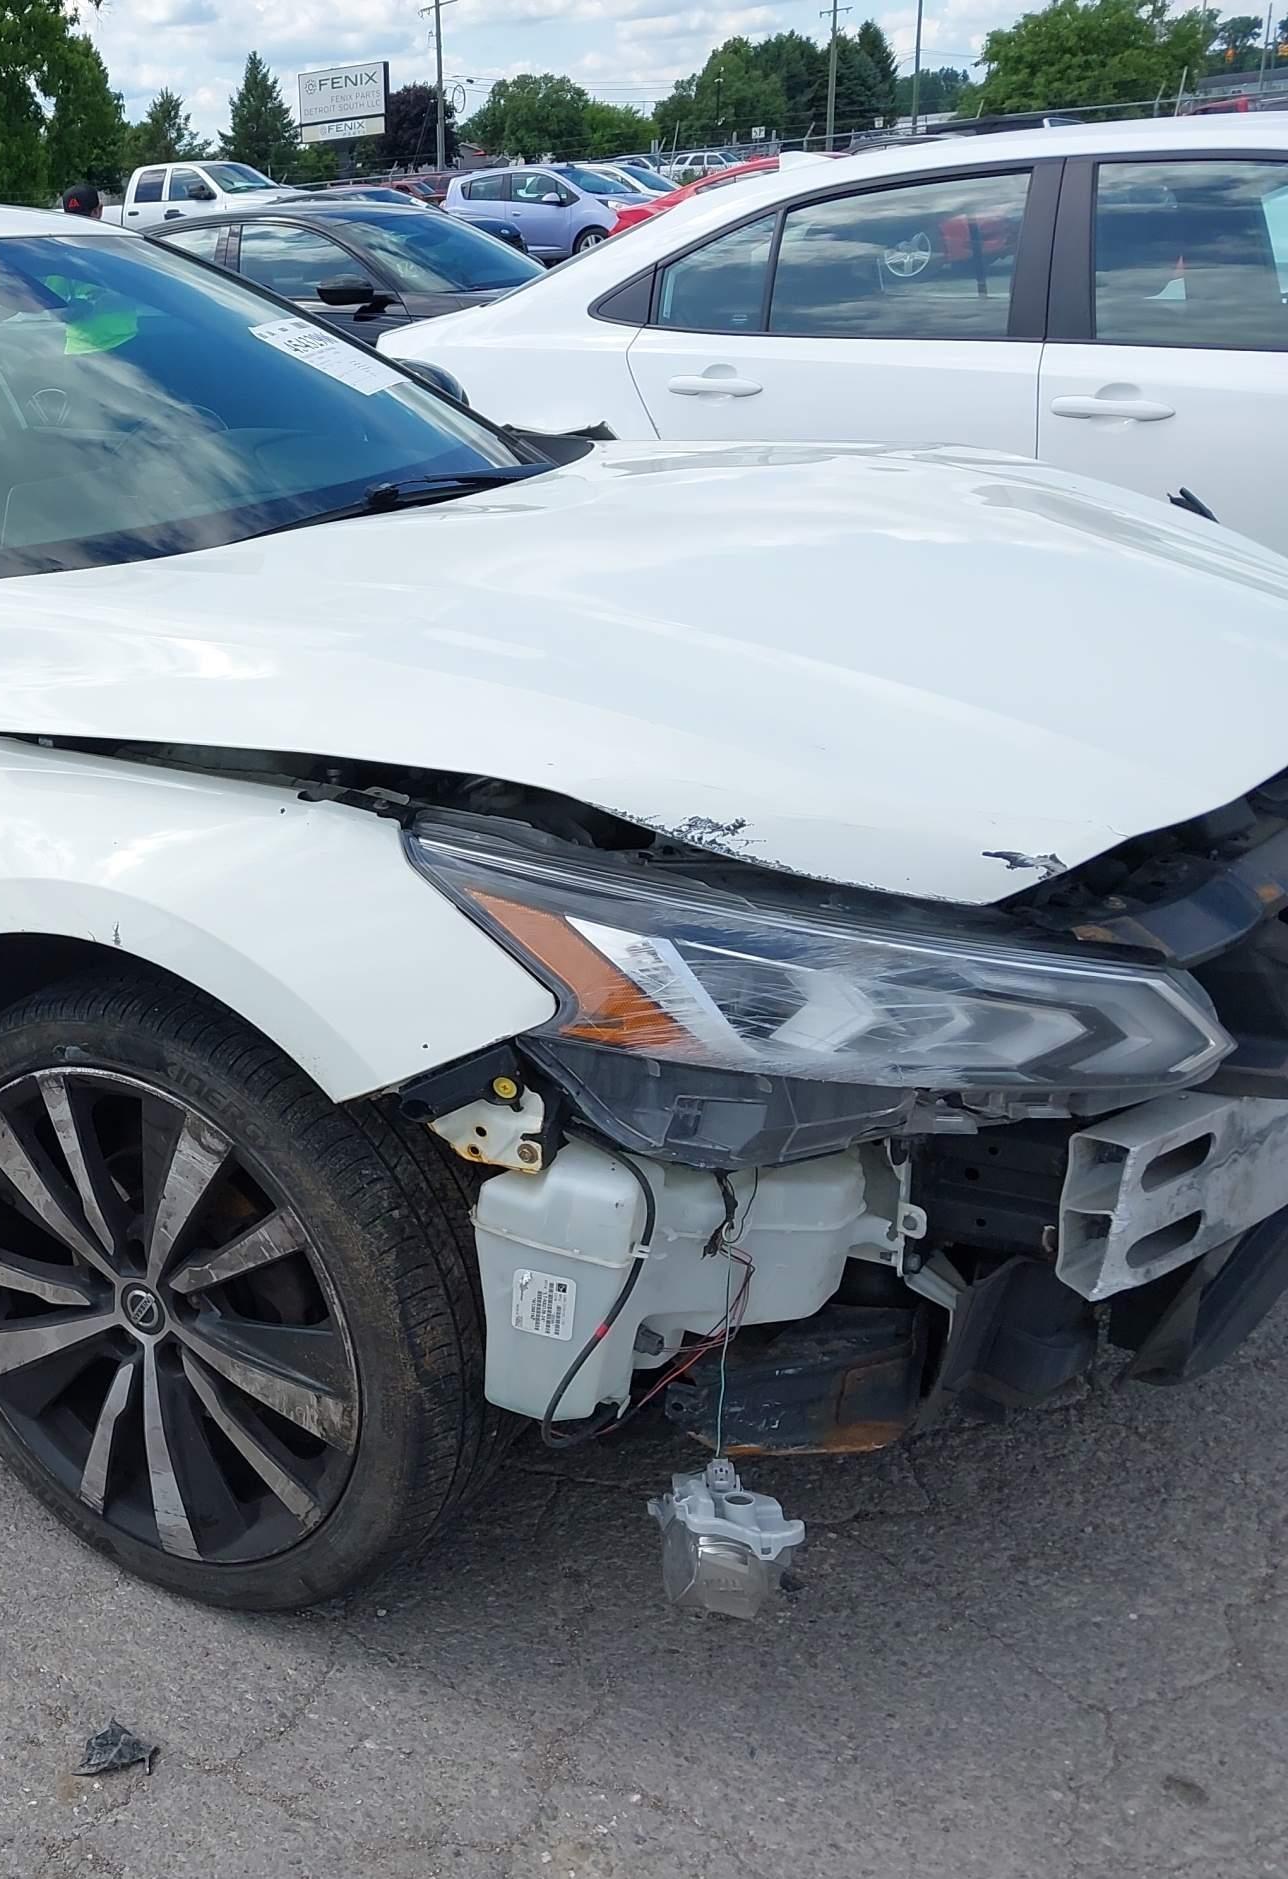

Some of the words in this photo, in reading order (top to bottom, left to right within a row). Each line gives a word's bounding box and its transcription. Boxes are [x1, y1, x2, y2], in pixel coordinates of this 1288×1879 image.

[318, 71, 378, 92] FENIX
[330, 94, 353, 104] FENIX
[355, 89, 381, 99] PARTS
[303, 104, 336, 116] DETROIT
[338, 102, 365, 112] SOUTH
[367, 99, 381, 108] LLC
[327, 120, 365, 134] FENIX
